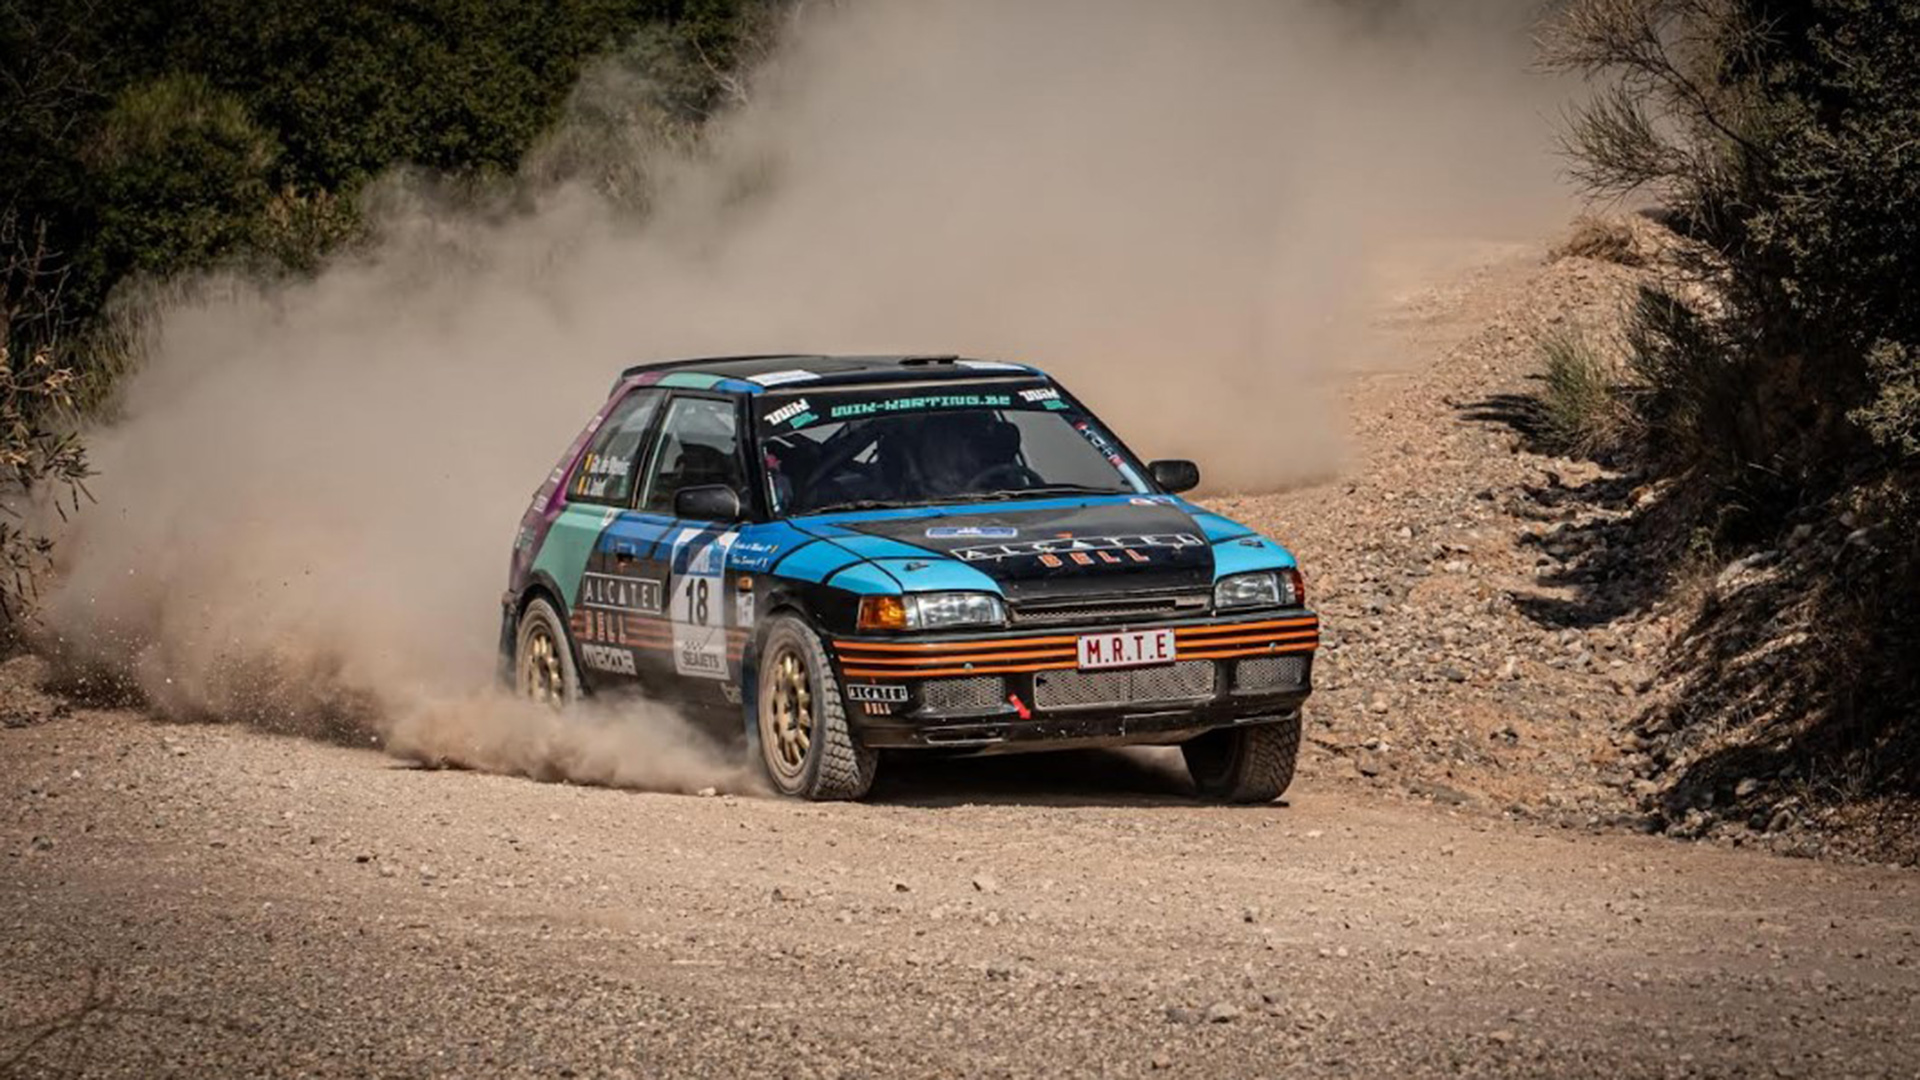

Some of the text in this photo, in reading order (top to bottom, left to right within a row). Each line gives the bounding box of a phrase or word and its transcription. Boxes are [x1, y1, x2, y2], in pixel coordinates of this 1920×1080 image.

[965, 535, 1202, 561] ALCATEL
[1038, 549, 1149, 568] BELL
[585, 579, 661, 609] ALCATEL
[686, 578, 708, 626] 18
[1087, 633, 1167, 664] M.R.T.E
